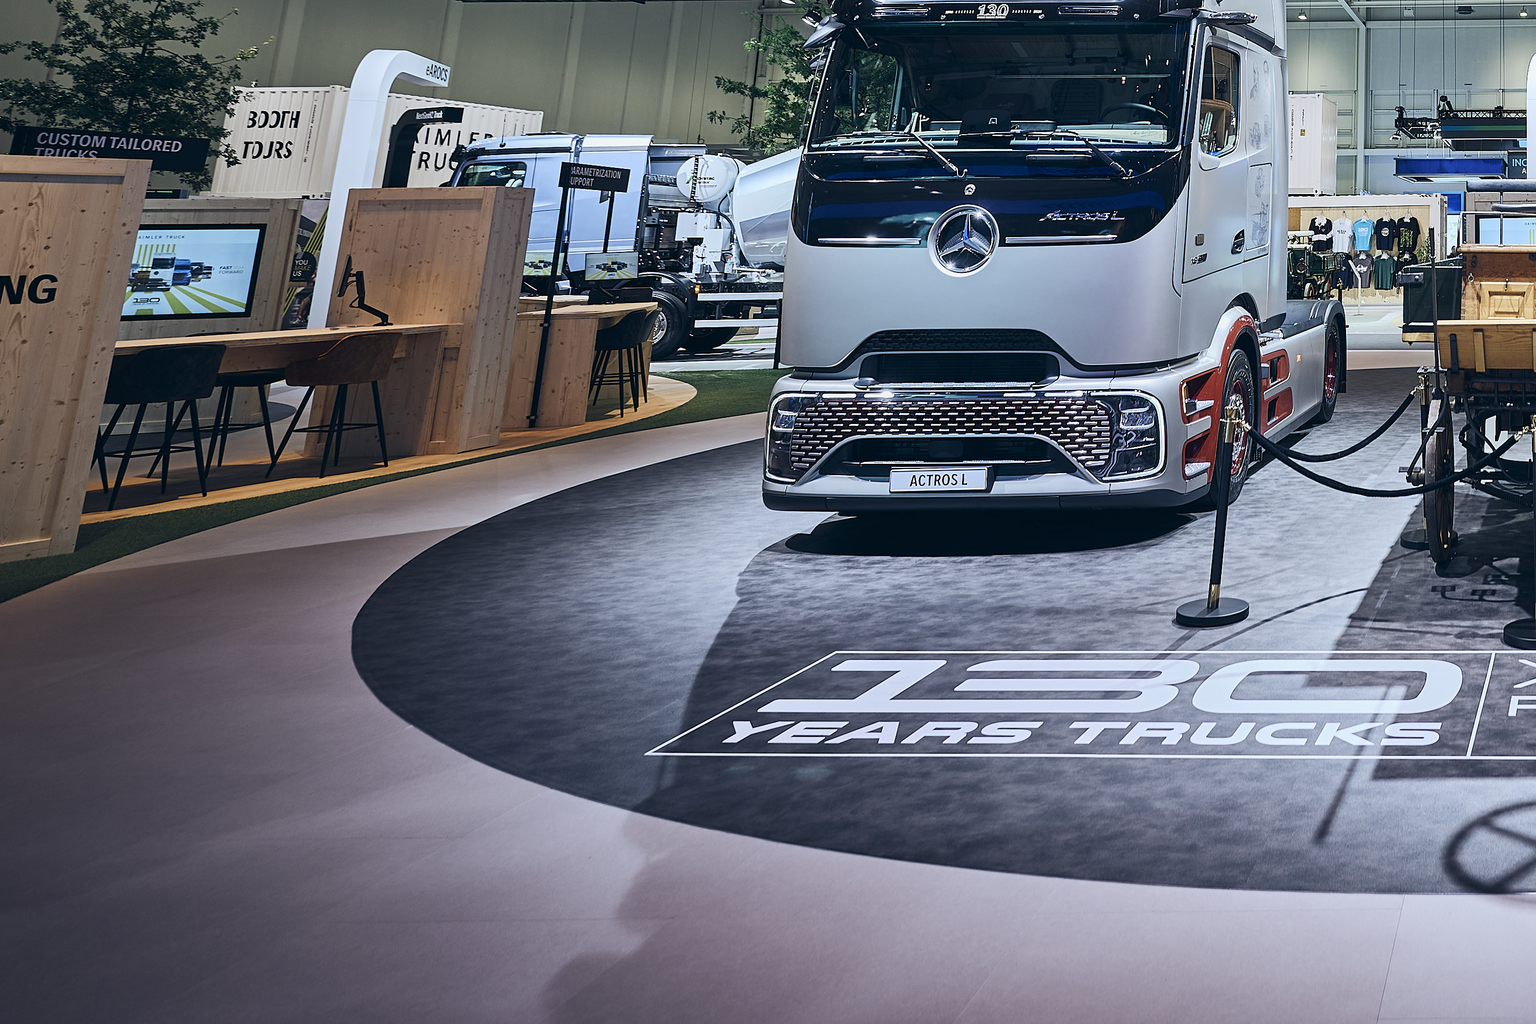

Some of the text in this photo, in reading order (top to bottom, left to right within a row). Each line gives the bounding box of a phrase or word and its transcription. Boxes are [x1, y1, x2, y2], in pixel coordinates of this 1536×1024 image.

[977, 3, 1010, 17] 130
[425, 64, 449, 82] eAROCS
[246, 110, 301, 129] BOOTH
[36, 132, 183, 153] CUSTOM TAILORED
[34, 147, 98, 159] TRUCKS
[569, 176, 595, 187] UPPORT
[0, 274, 58, 304] NG
[909, 473, 968, 487] ACTROS L
[756, 659, 1464, 714] 130
[721, 721, 1443, 747] YEARS TRUCKS
